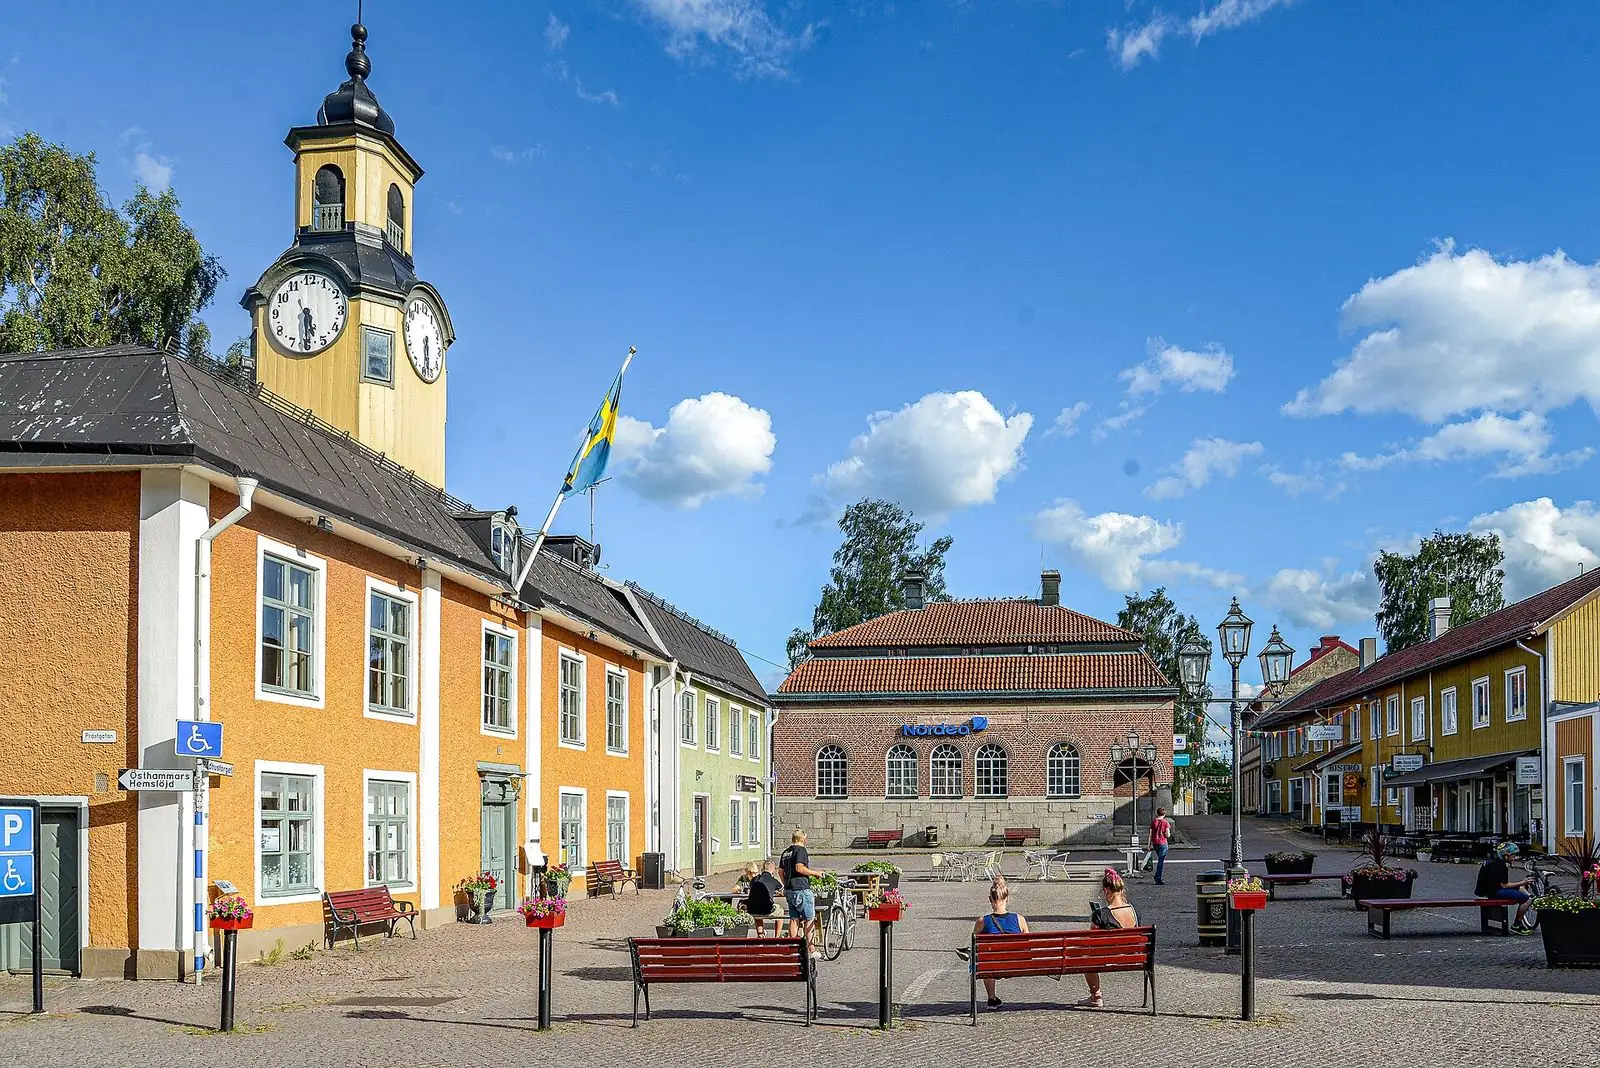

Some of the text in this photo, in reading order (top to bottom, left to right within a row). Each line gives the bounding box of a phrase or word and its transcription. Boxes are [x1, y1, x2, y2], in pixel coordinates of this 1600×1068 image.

[303, 275, 316, 285] 12
[321, 279, 327, 289] 1
[289, 281, 299, 291] 11
[278, 293, 289, 303] 10
[332, 289, 339, 299] 2
[272, 309, 279, 319] 9
[337, 305, 344, 315] 3
[276, 325, 283, 336] 8
[332, 322, 339, 332] 4
[405, 322, 410, 333] 9
[289, 337, 295, 347] 7
[320, 336, 327, 346] 5
[902, 723, 970, 735] Nordea
[1330, 764, 1360, 772] BISTRO
[130, 770, 190, 780] Östhammars
[129, 780, 174, 789] Hemslöjd
[4, 814, 23, 847] P
